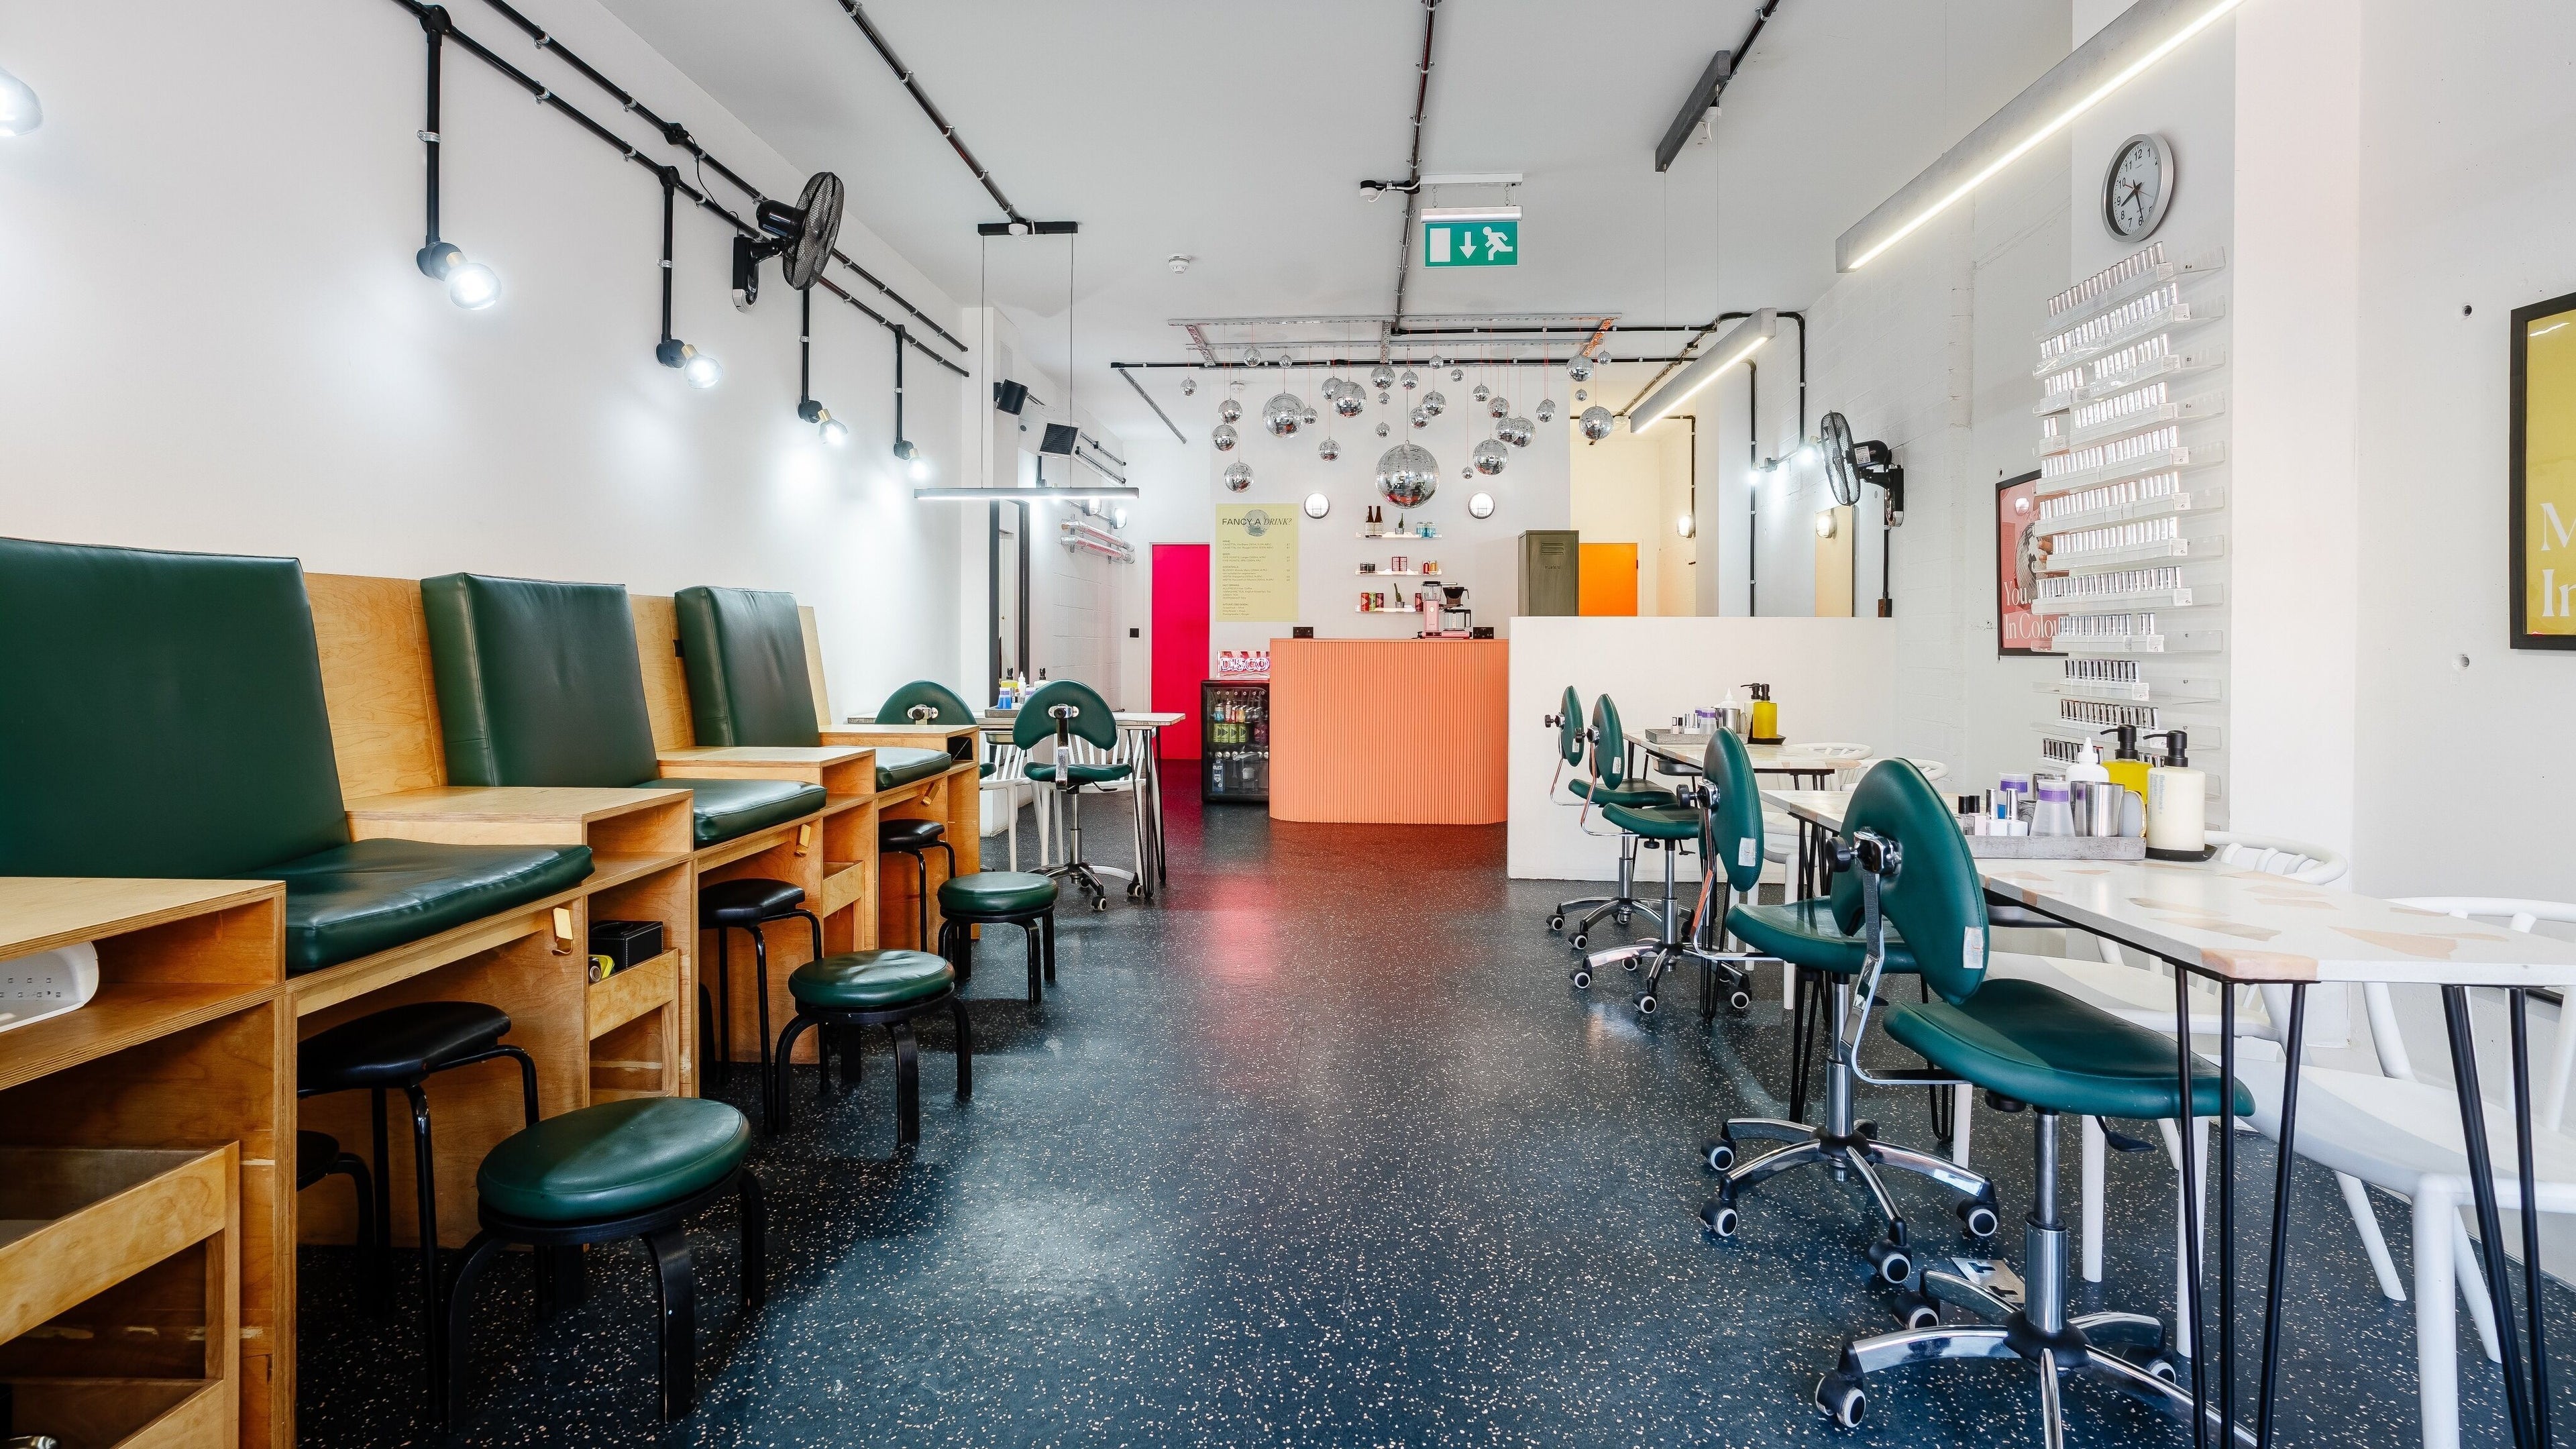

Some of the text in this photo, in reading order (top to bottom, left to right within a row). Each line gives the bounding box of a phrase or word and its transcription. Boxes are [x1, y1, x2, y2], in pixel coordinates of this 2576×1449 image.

[2135, 149, 2143, 162] 12
[2125, 160, 2133, 172] 11
[2118, 178, 2126, 189] 10
[2116, 196, 2121, 206] 9
[2121, 210, 2125, 220] 8
[2128, 217, 2133, 227] 7
[2004, 580, 2032, 606] You.
[2004, 614, 2017, 639] In
[1220, 657, 1270, 672] DISCO
